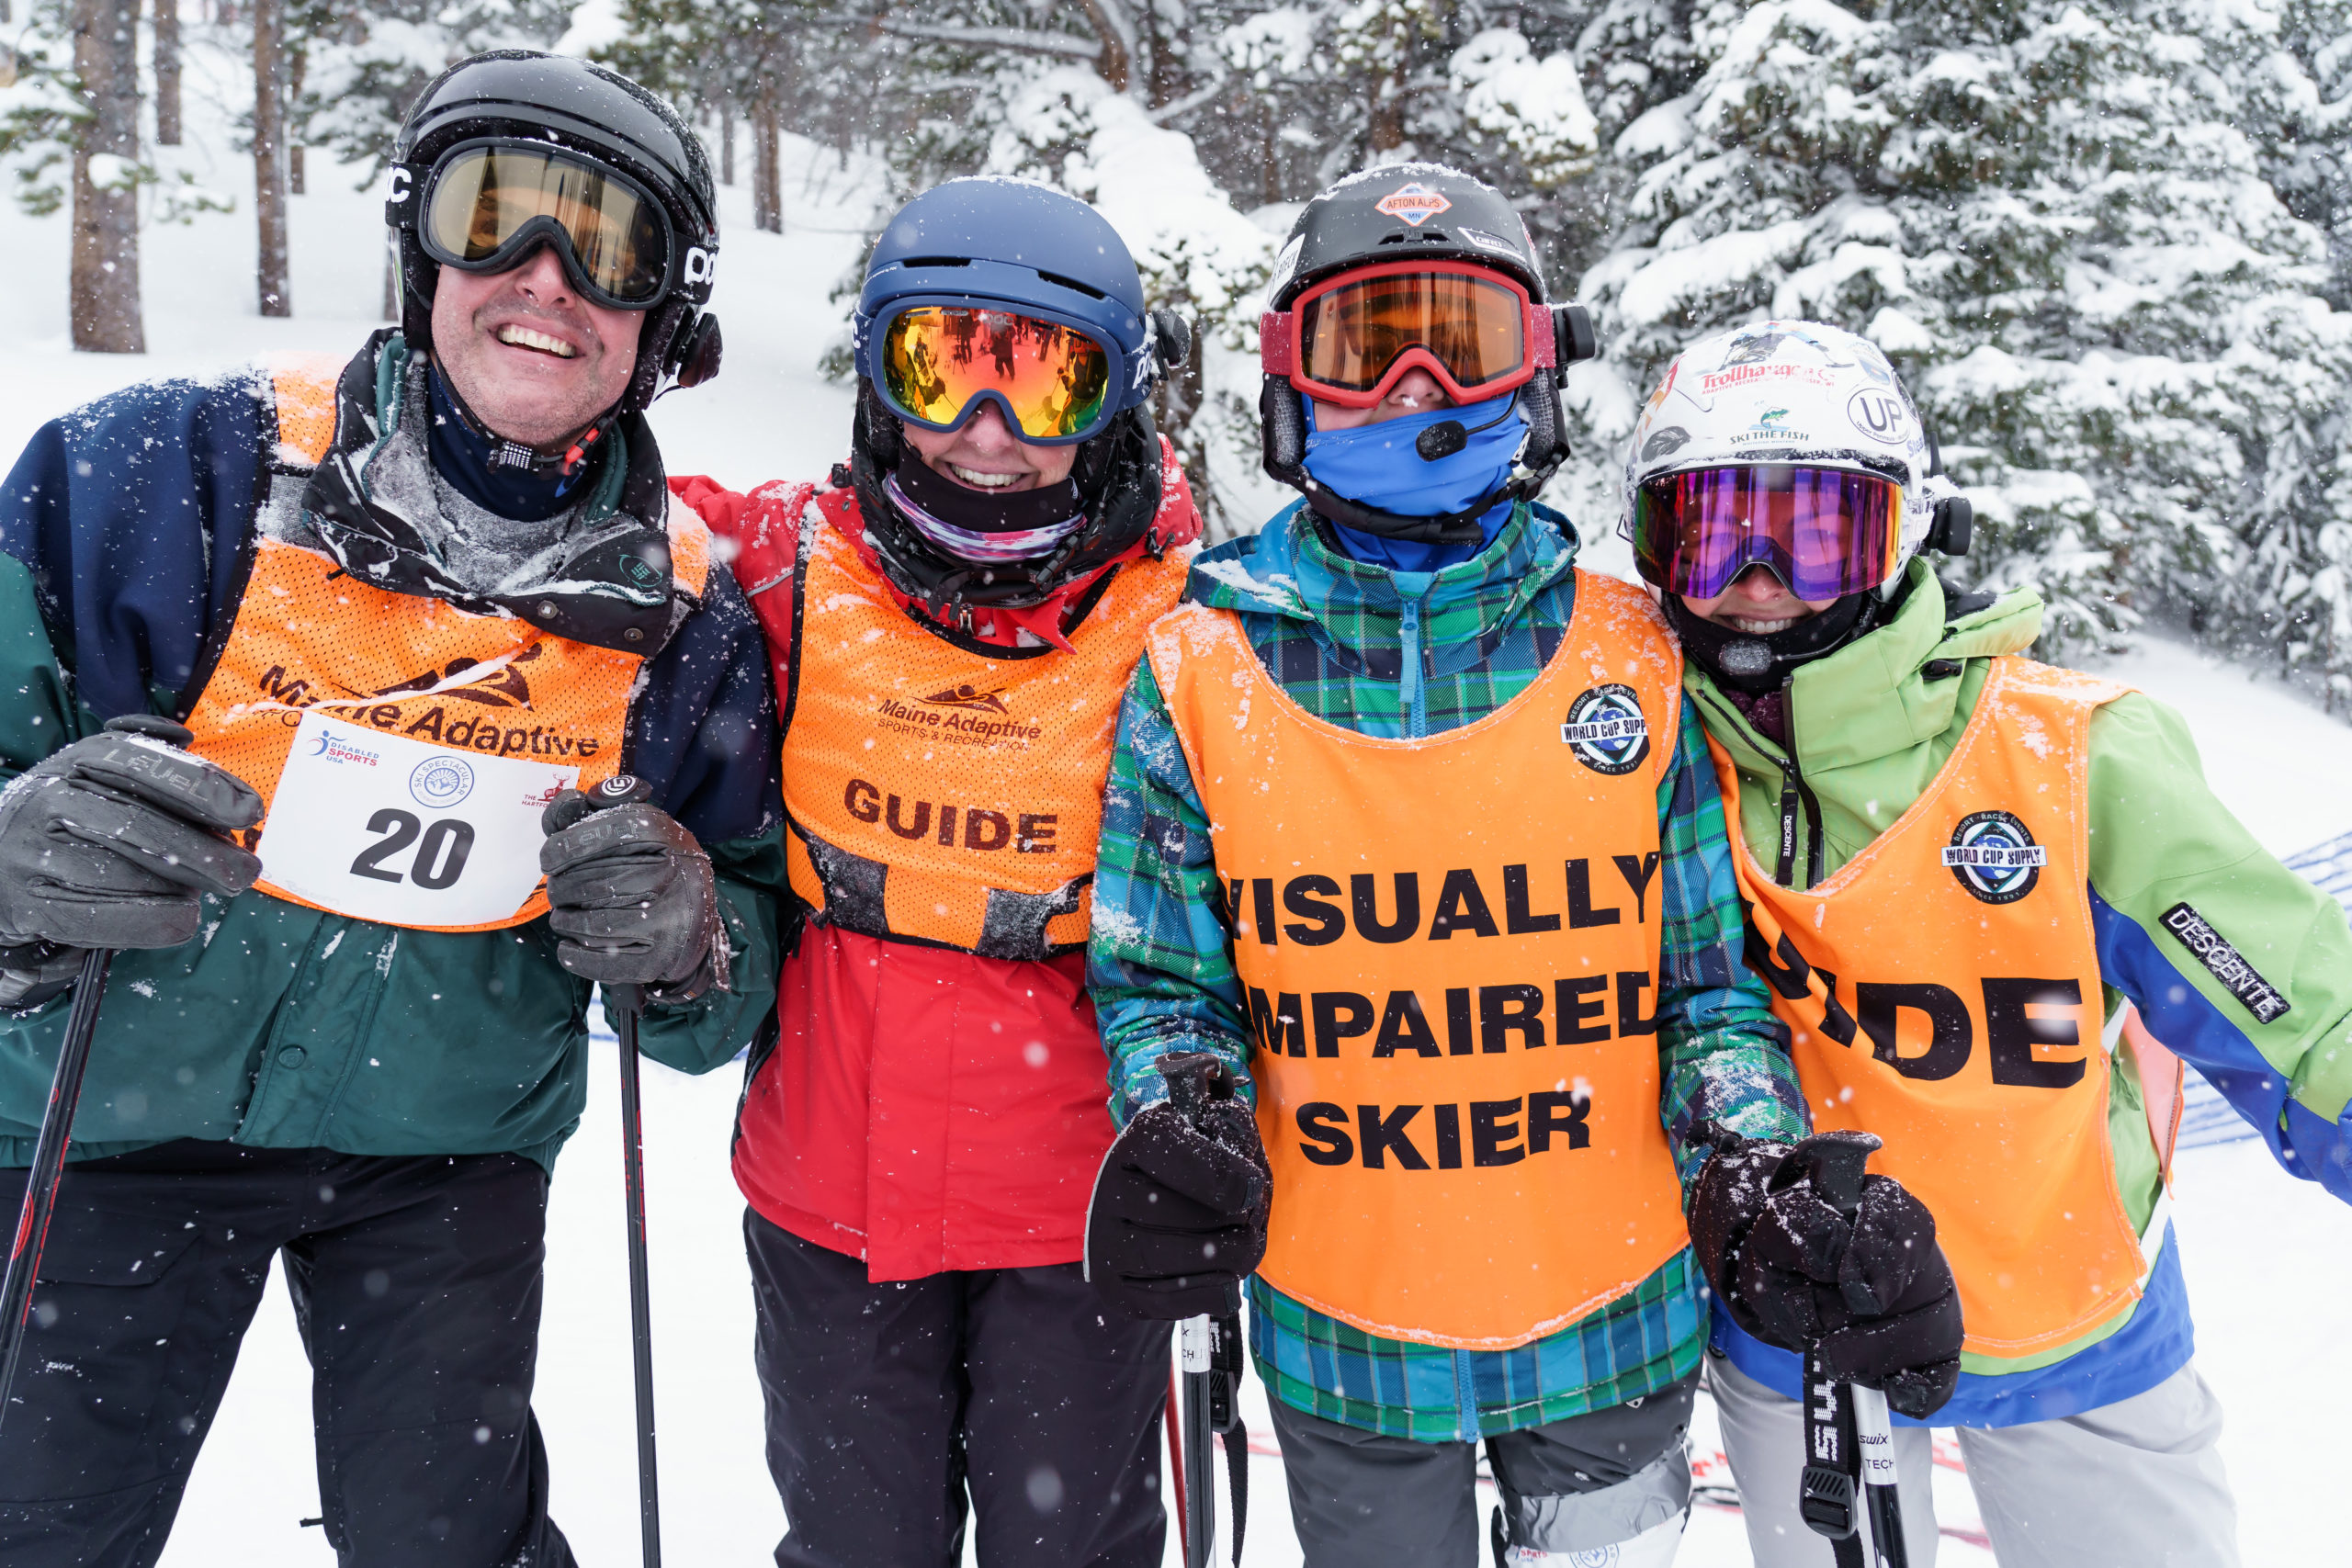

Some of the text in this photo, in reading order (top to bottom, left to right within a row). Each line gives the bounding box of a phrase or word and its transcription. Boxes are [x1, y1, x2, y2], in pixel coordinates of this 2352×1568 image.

[1387, 197, 1440, 209] AFTON ALPS
[1860, 397, 1902, 432] UP
[1729, 431, 1809, 445] SKI THE FISH
[877, 699, 1042, 739] Maine Adaptive
[879, 718, 928, 739] SPORTS
[931, 731, 940, 740] &
[1564, 718, 1646, 740] WORLD CUP SUPP
[405, 706, 600, 758] Adaptive
[326, 755, 344, 764] USA
[328, 748, 378, 767] SPORTS
[331, 741, 379, 759] DISABLED
[414, 760, 469, 795] SKI SPECTACULAR
[521, 800, 549, 808] HARTFO
[843, 778, 1058, 854] GUIDE
[1783, 815, 1792, 857] DESCENTE
[1953, 817, 1974, 841] RESORT
[2010, 817, 2030, 842] EVENTS
[349, 807, 475, 890] 20
[1946, 848, 2041, 864] WORLD CUP SUPPLY
[1217, 851, 1661, 947] VISUALLY
[2167, 908, 2284, 1017] DESCENTE
[1246, 970, 1658, 1059] MPAIRED
[1295, 1090, 1591, 1171] SKIER
[1859, 1433, 1889, 1445] swix
[1865, 1458, 1894, 1470] TECH
